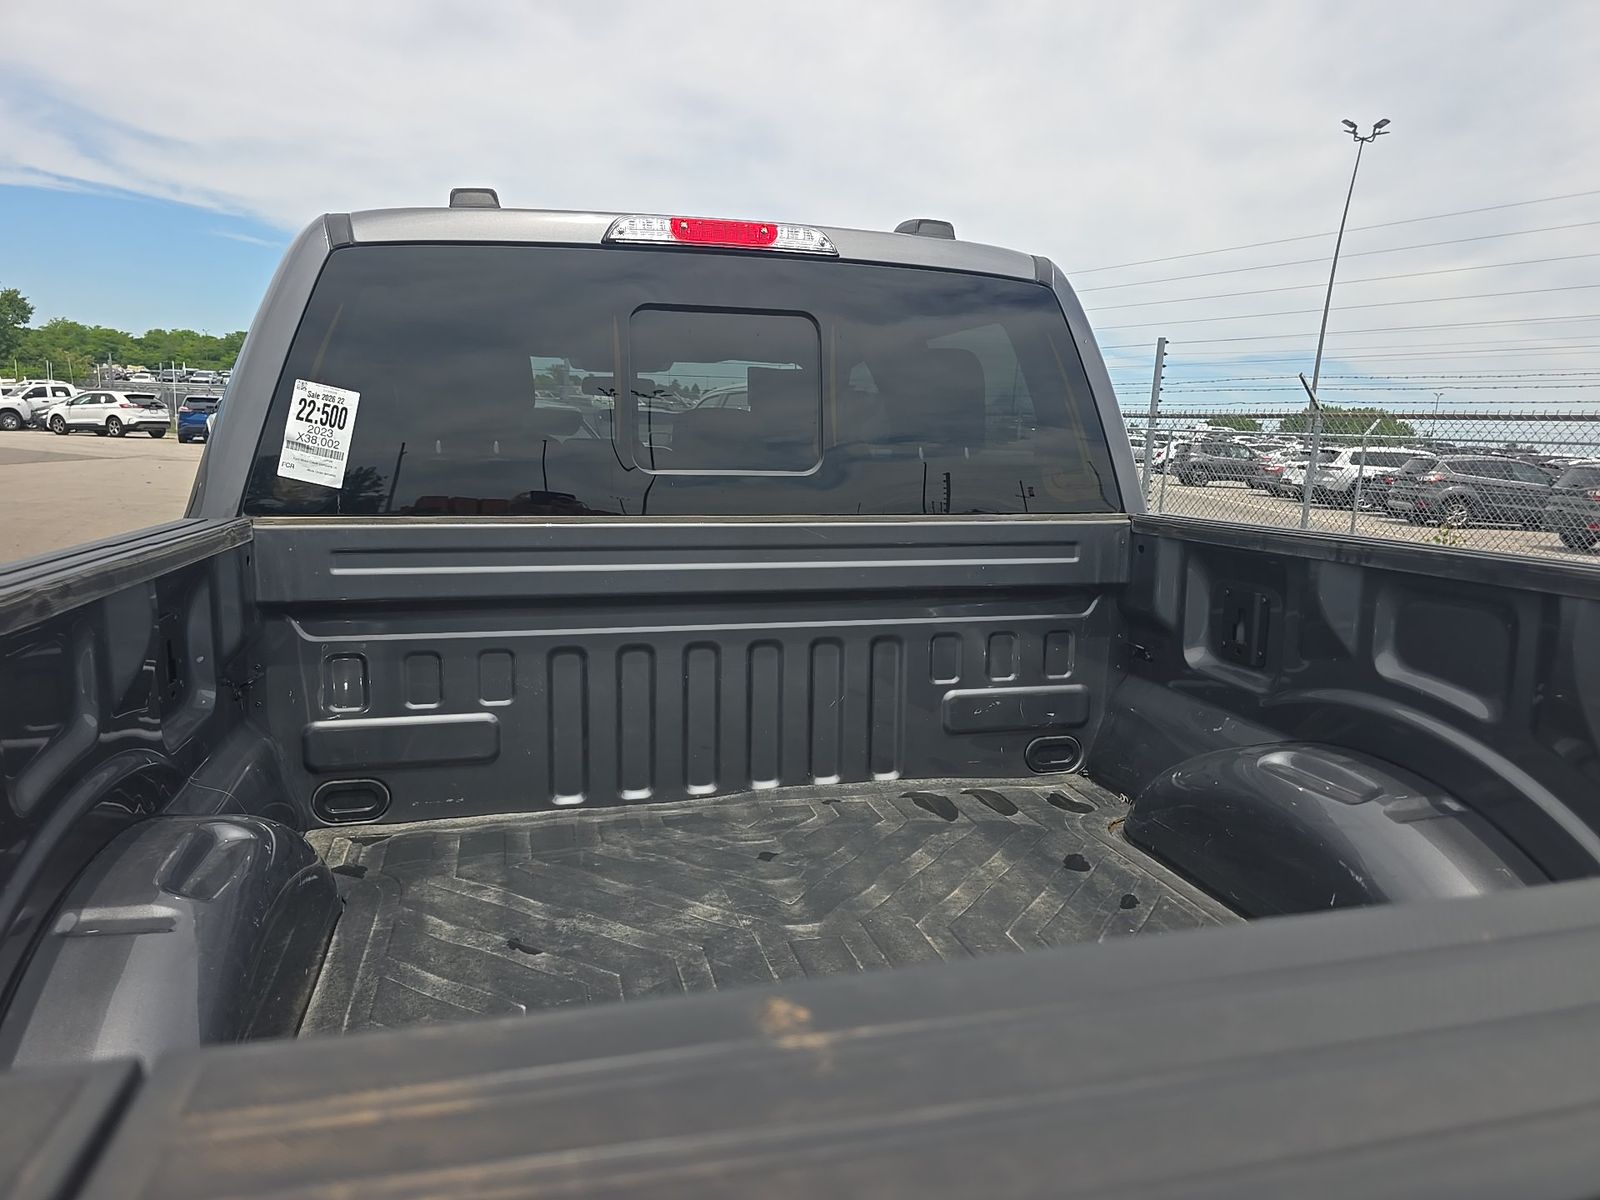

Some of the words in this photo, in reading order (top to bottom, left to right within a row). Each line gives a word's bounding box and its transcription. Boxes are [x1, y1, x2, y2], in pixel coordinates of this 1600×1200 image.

[307, 390, 320, 400] Sale
[321, 394, 336, 403] 2026
[337, 397, 345, 405] 22
[296, 398, 348, 430] 22:500
[307, 425, 334, 438] 2023
